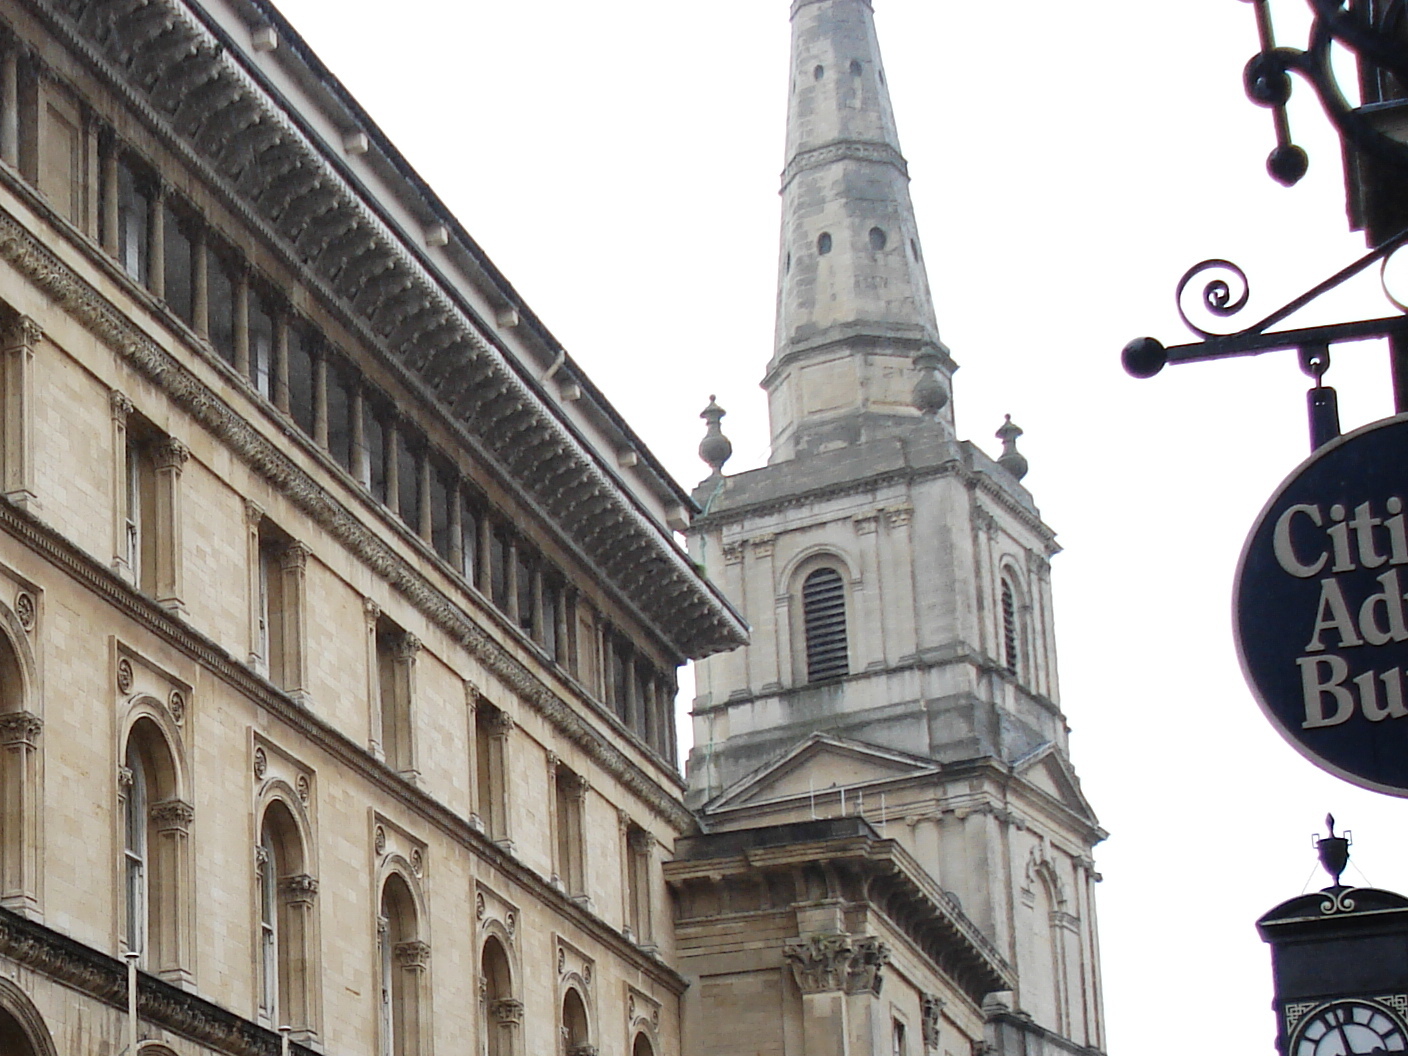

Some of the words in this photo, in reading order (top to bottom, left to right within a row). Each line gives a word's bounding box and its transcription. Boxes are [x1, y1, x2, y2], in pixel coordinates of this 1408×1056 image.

[1272, 496, 1408, 579] Citi
[1305, 569, 1408, 653] Ad
[1295, 653, 1408, 730] Bu
